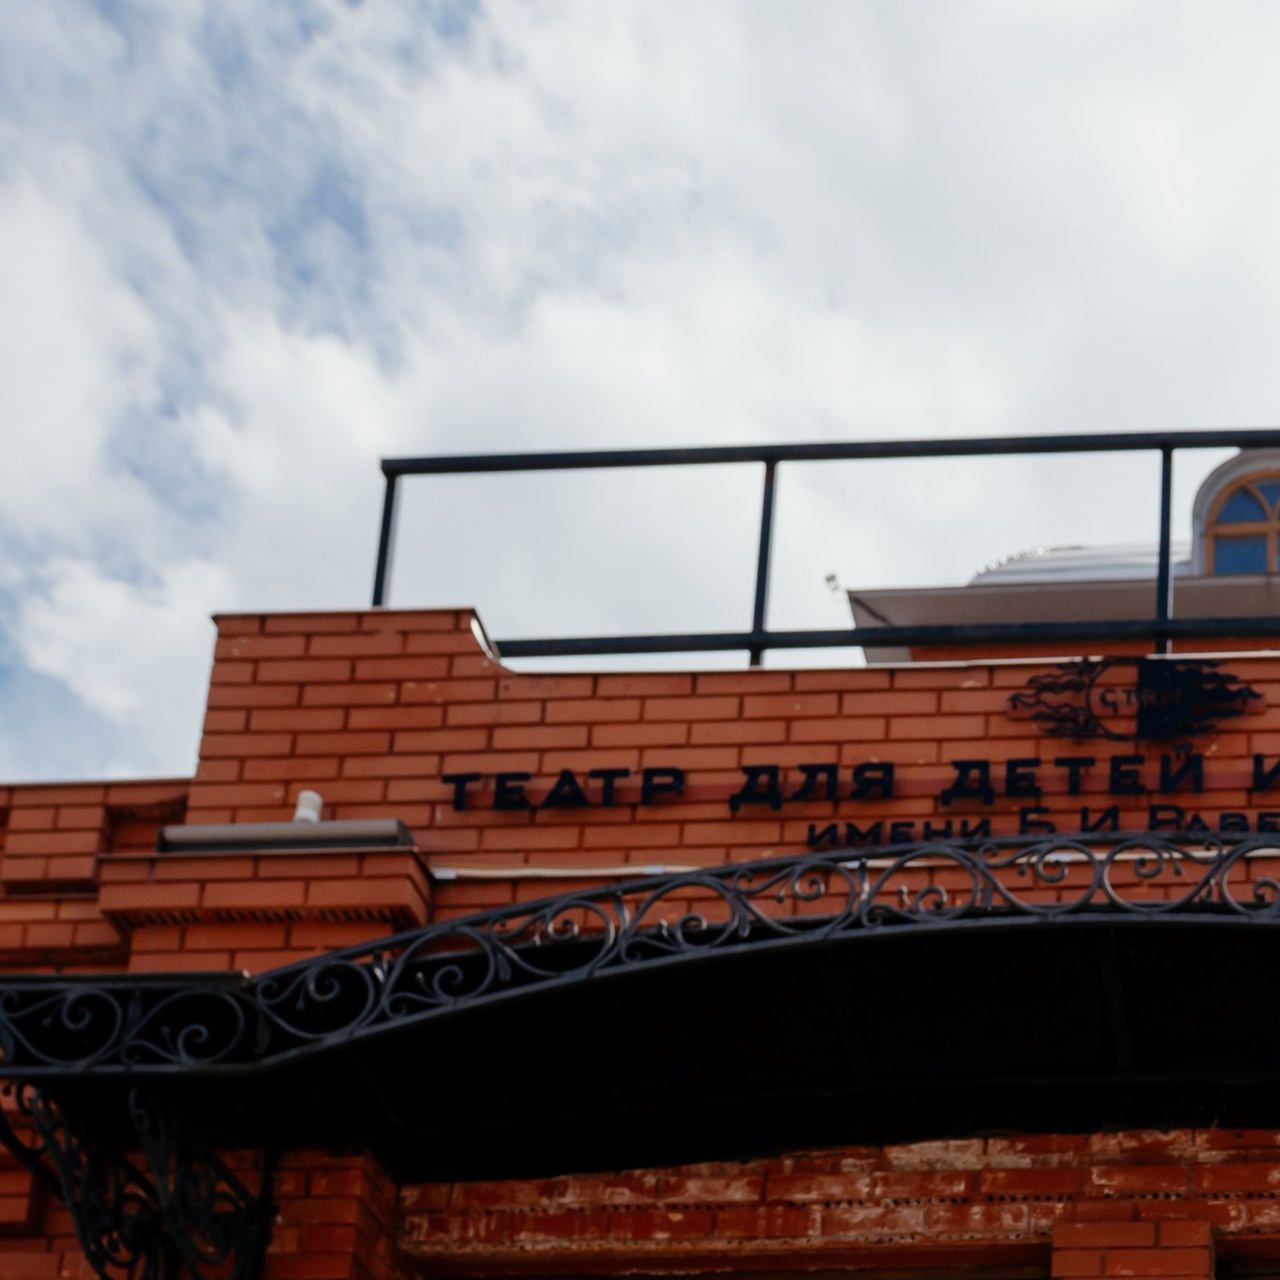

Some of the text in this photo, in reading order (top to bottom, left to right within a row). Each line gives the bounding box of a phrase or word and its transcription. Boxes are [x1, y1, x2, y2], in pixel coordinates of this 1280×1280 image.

[441, 767, 687, 811] ТЕАТР
[729, 762, 895, 812] ДЛЯ
[941, 743, 1204, 807] ДЕТЕЙ
[807, 820, 992, 848] ИМЕНИ
